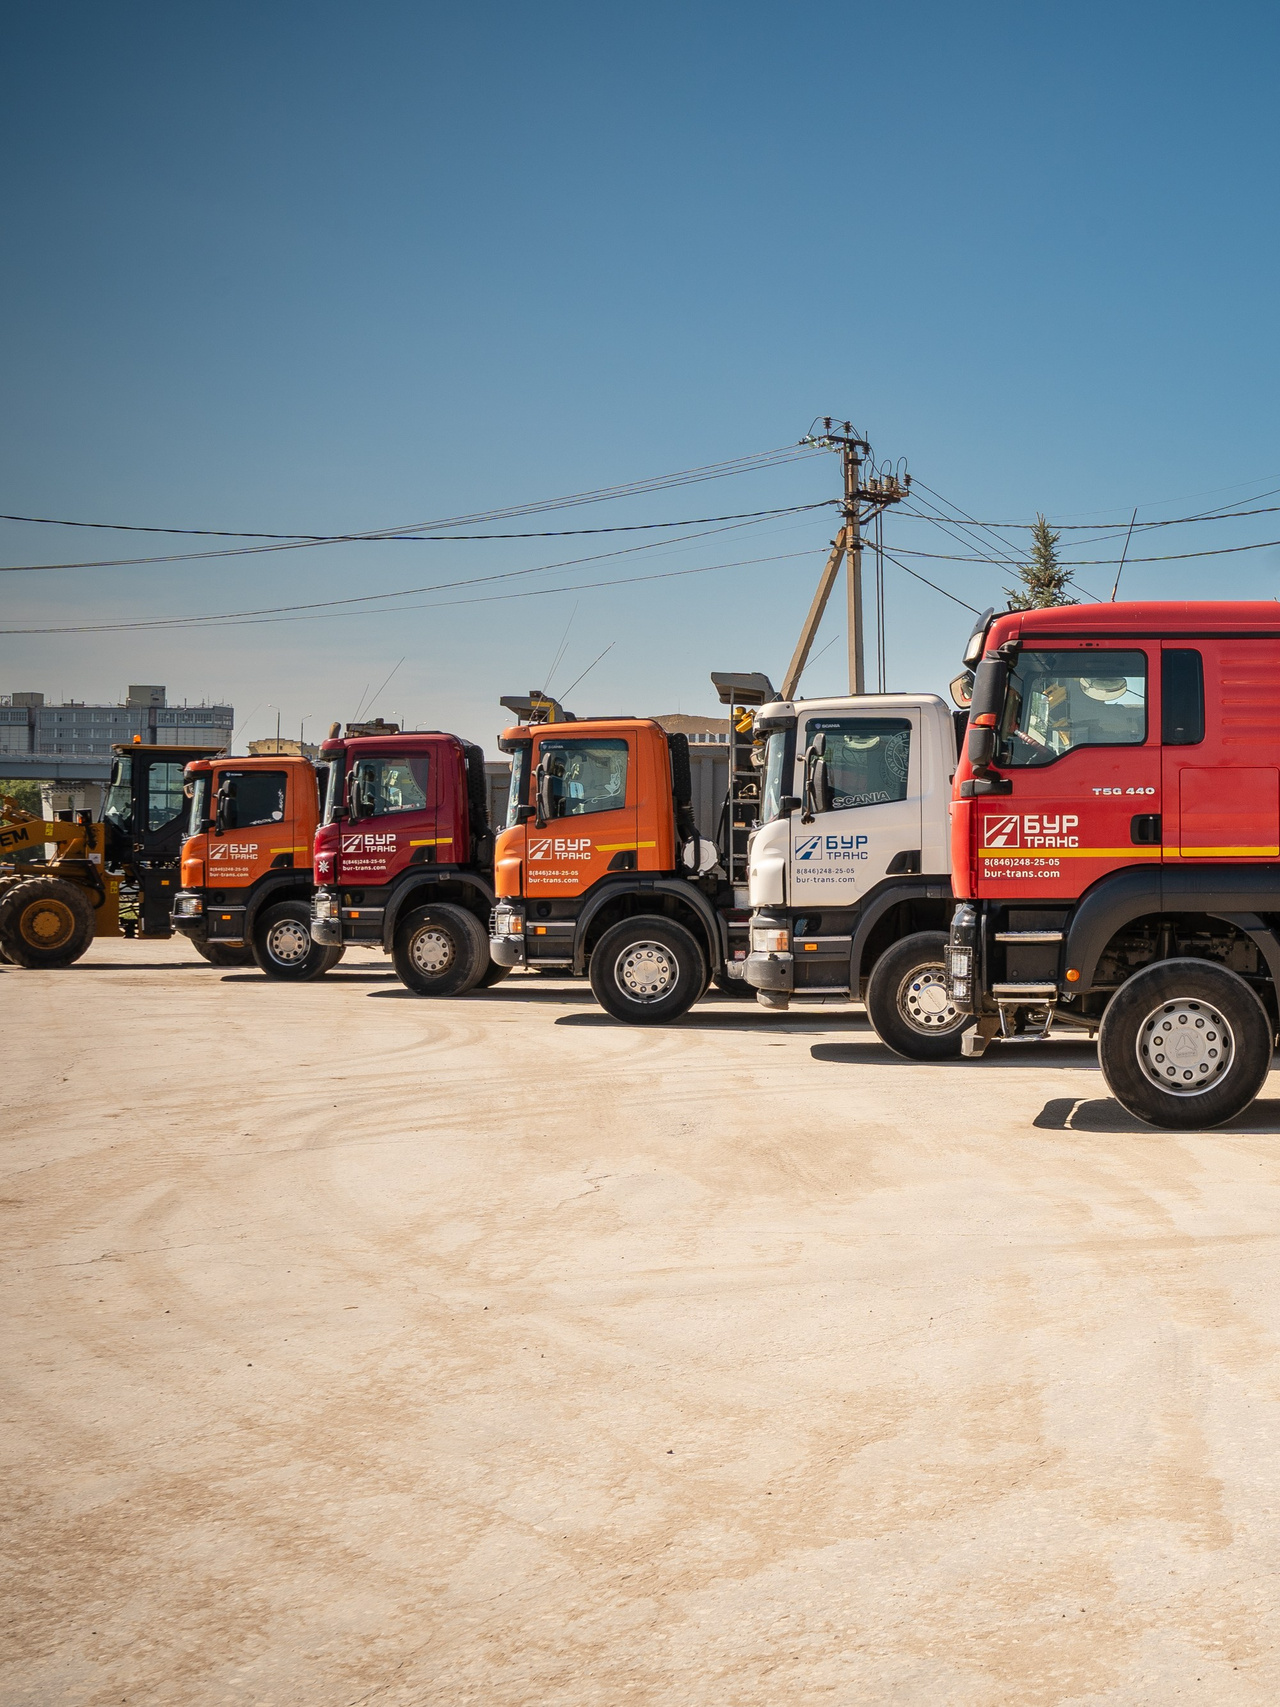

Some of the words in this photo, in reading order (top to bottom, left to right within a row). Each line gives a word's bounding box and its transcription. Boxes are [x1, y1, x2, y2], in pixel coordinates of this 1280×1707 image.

[1125, 787, 1156, 796] 440
[832, 790, 891, 809] SCANIA
[1024, 815, 1079, 834] БУР
[364, 834, 397, 845] БУР
[826, 835, 868, 849] БУР
[1024, 836, 1079, 848] ТРАНС
[230, 844, 258, 853] БУР
[364, 845, 397, 853] ТРАНС
[554, 838, 592, 851] БУР
[554, 852, 592, 860] ТРАНС
[826, 851, 868, 860] ТРАНС
[984, 858, 1060, 867] 8(846)248-25-05
[796, 867, 855, 875] 8(846)248-25-05
[984, 868, 1060, 878] bur-trans.com
